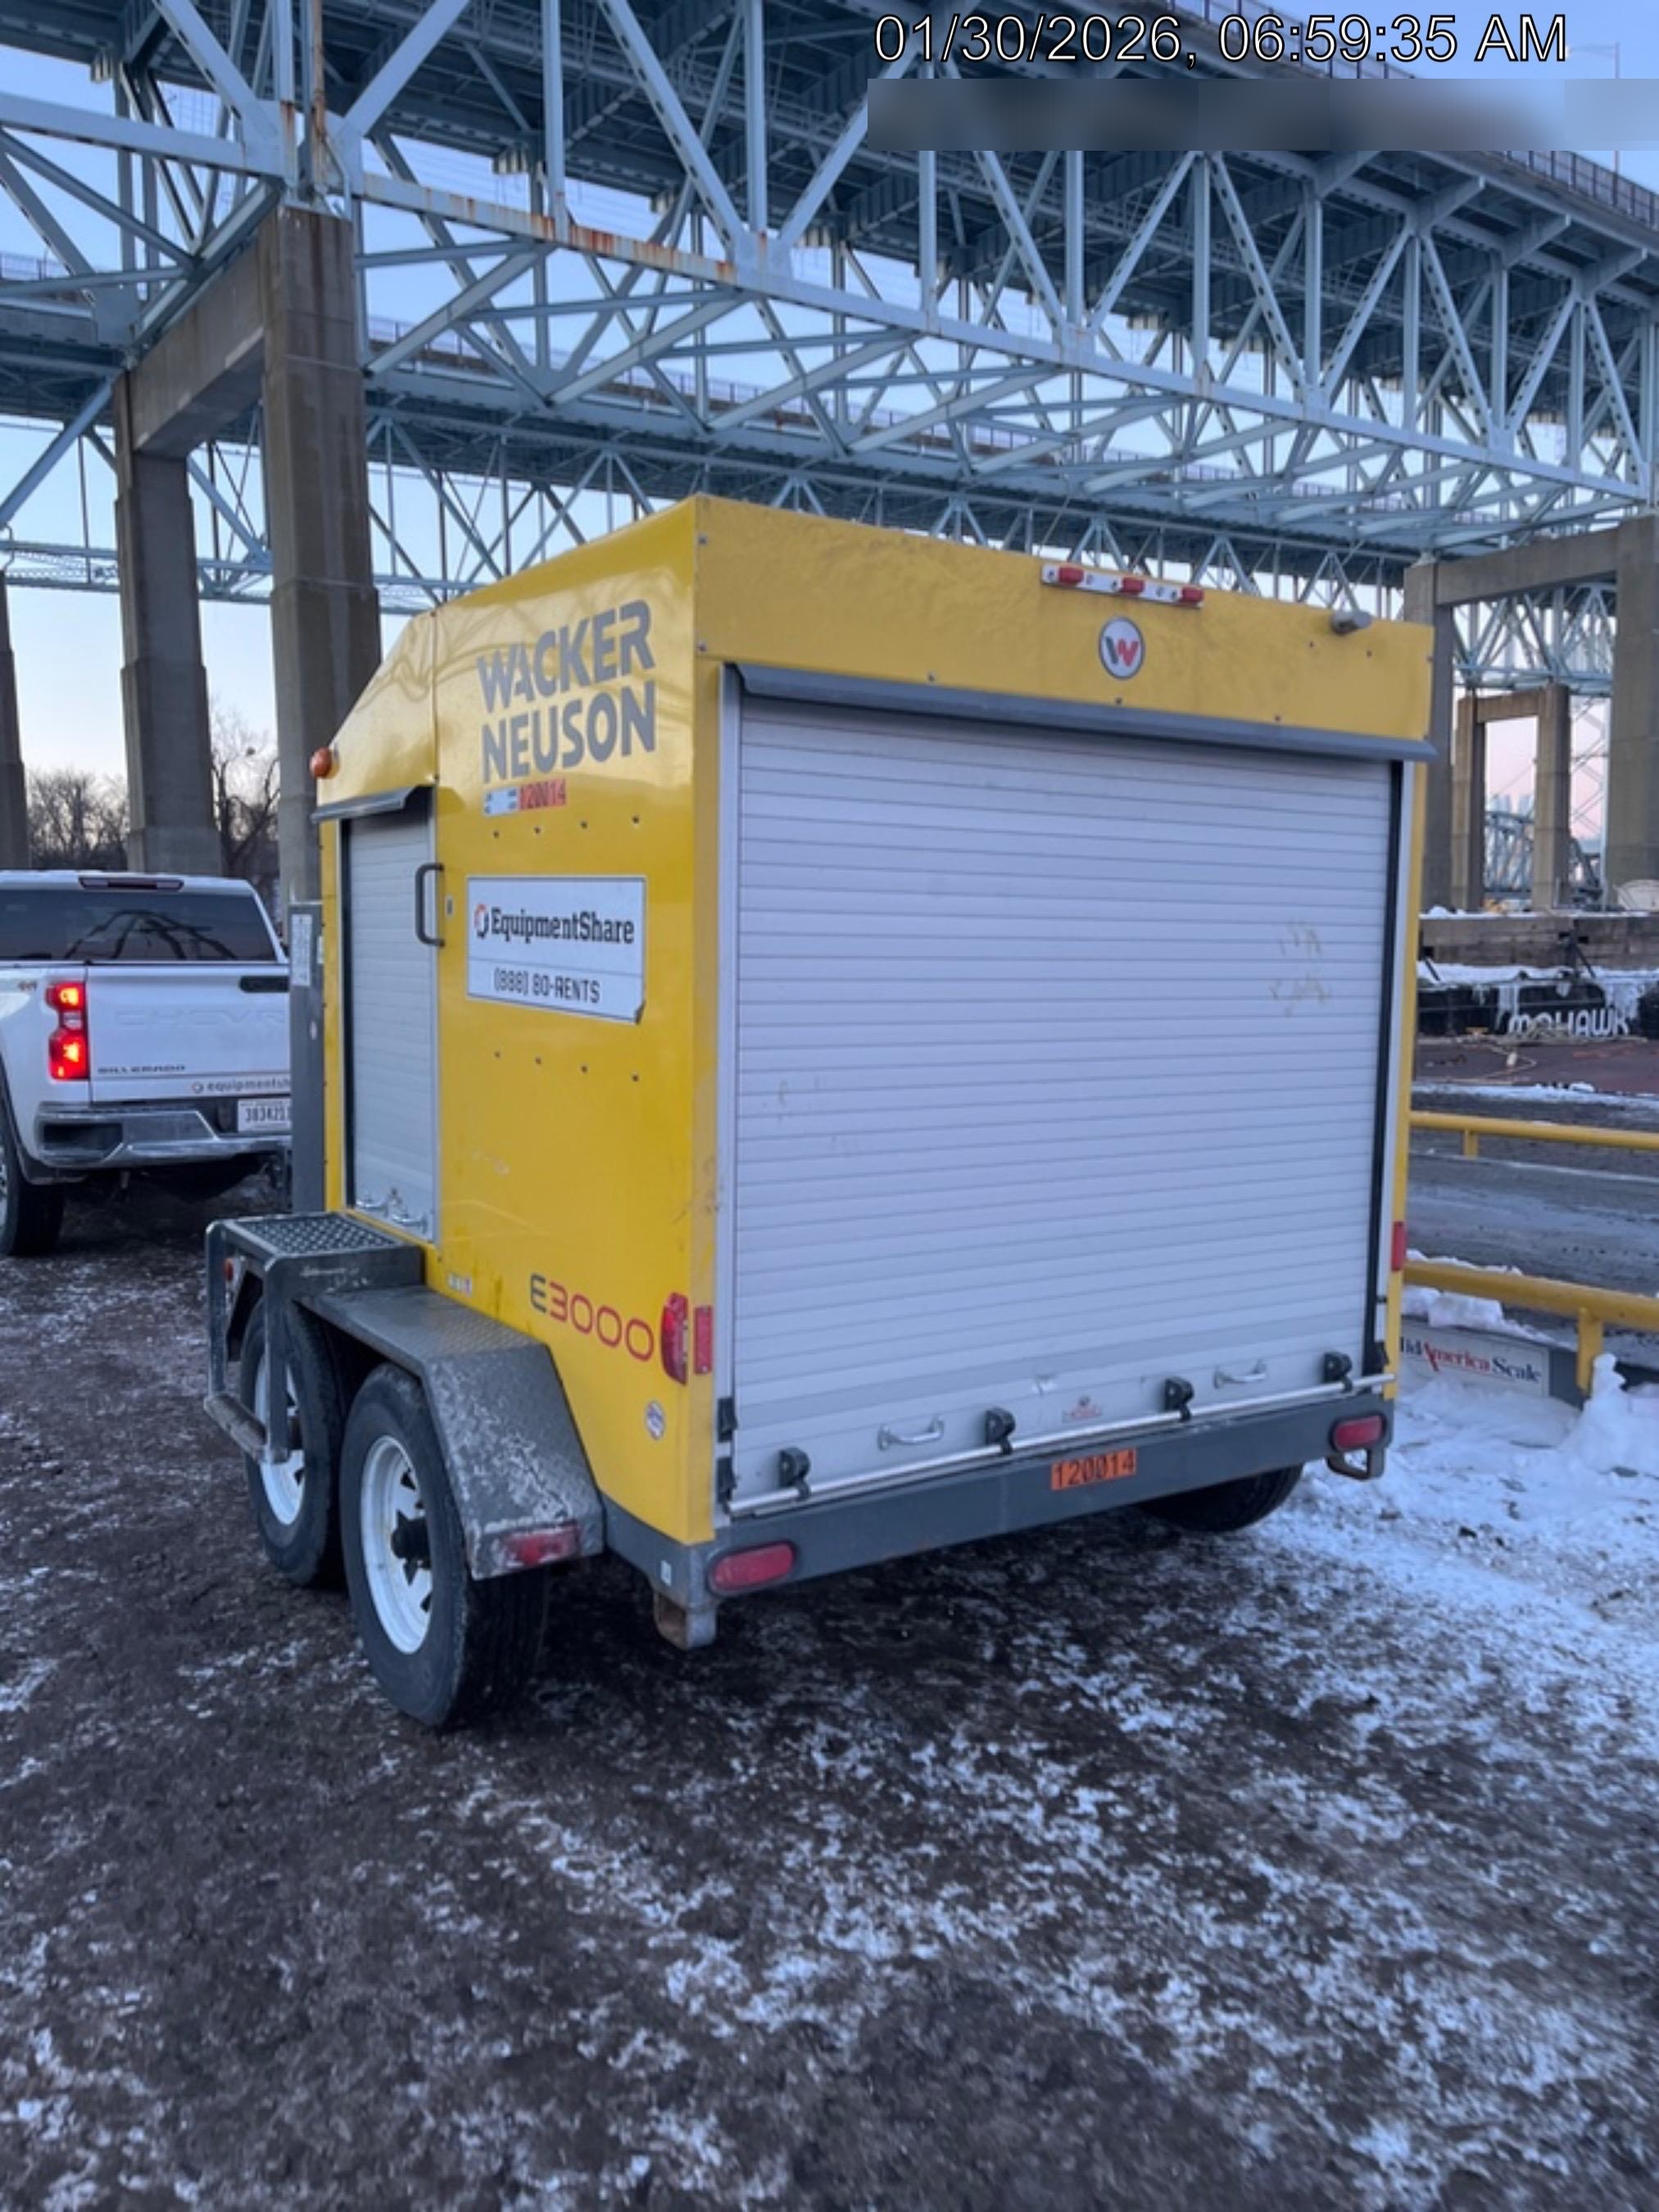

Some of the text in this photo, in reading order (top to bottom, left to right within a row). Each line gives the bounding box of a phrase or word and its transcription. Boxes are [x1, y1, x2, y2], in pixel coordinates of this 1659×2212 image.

[476, 599, 655, 714] WACKER
[481, 679, 655, 785] NEUSON
[491, 906, 635, 944] EquipmentShare
[493, 968, 601, 1004] (888) 80-RENTS
[530, 1272, 655, 1362] E3000
[1400, 1336, 1491, 1372] idAmerica
[1053, 1448, 1135, 1489] 120014
